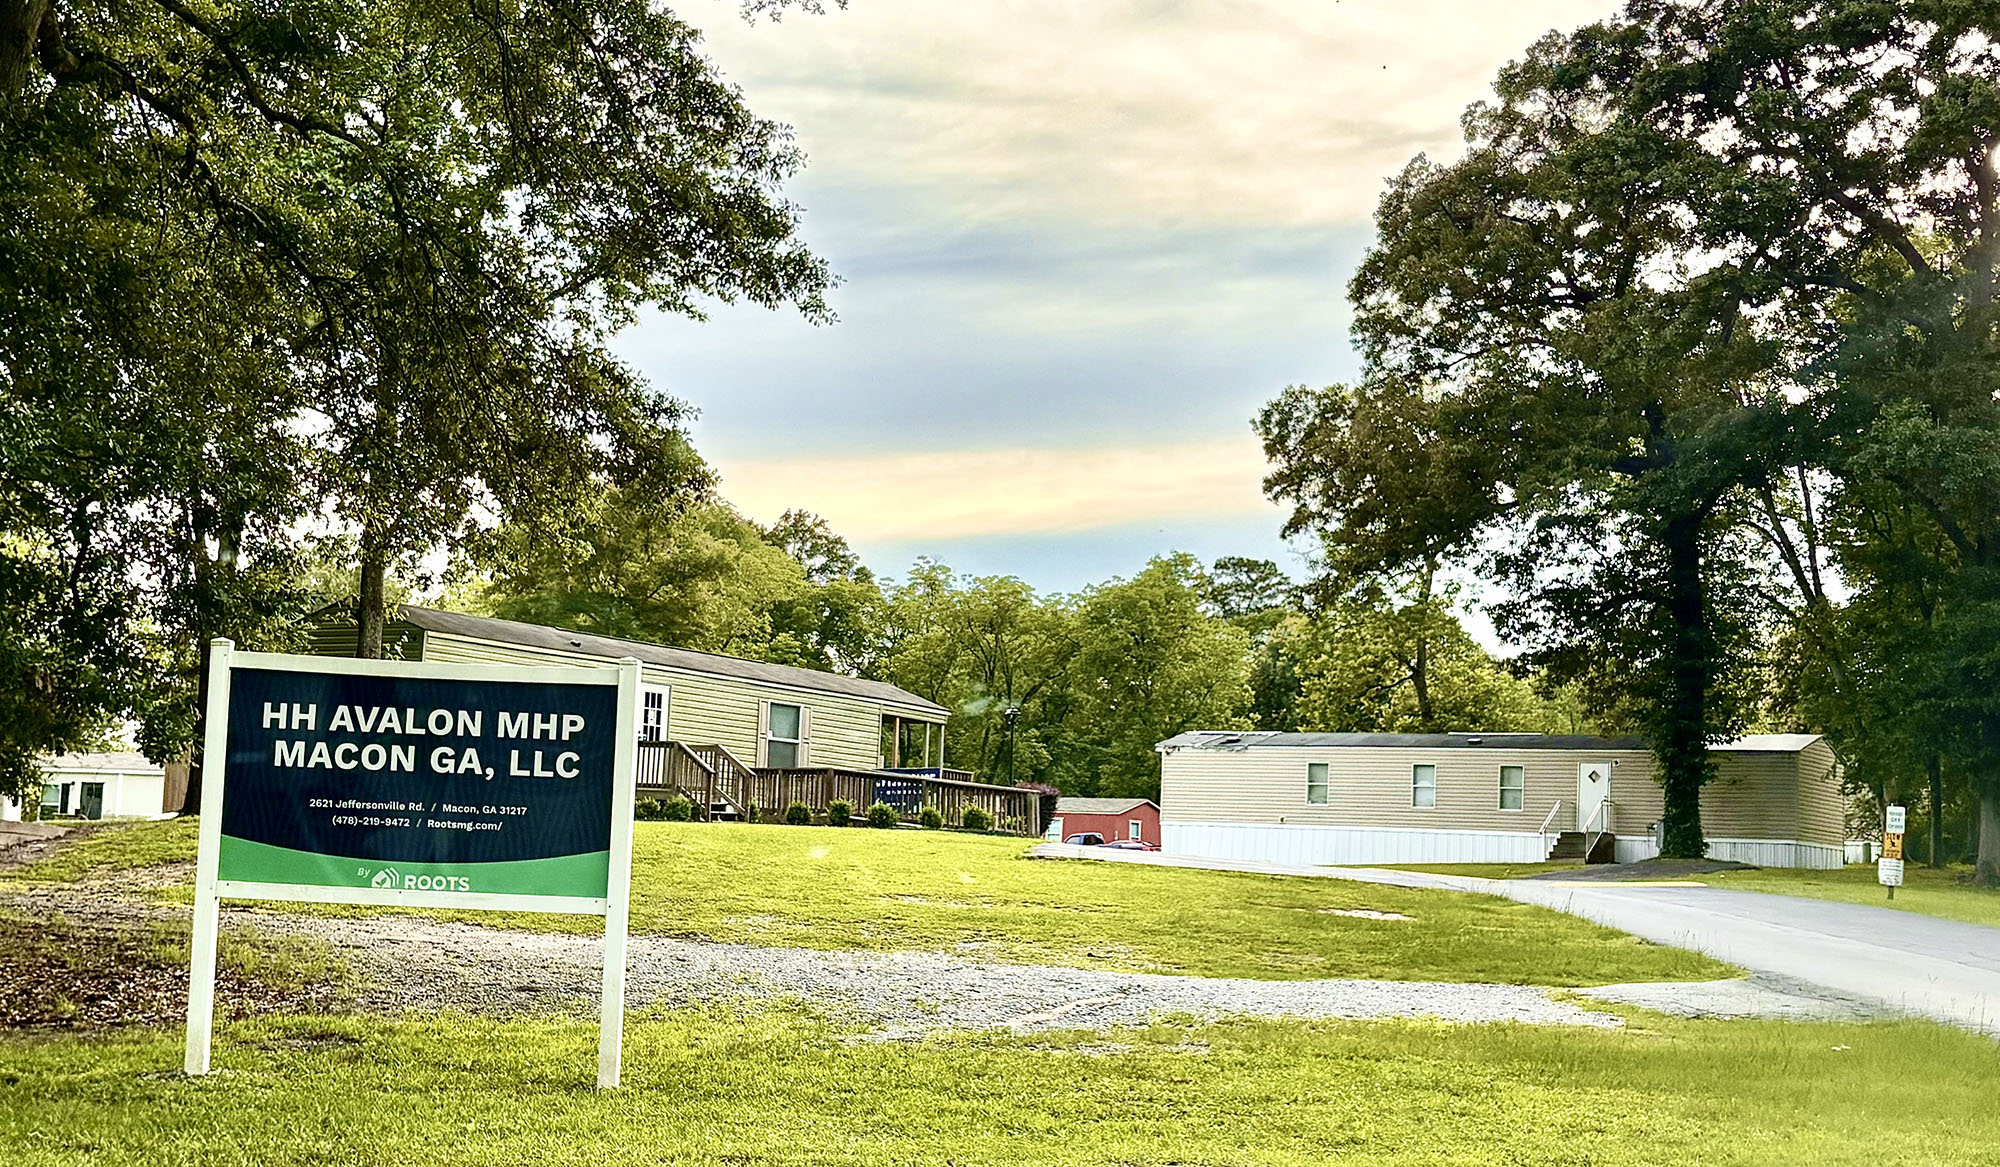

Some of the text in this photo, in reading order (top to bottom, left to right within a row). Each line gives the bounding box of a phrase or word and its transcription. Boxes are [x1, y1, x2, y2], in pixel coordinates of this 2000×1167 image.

[262, 701, 585, 741] HH AVALON MHP
[273, 739, 581, 781] MACON GA, LLC
[309, 798, 528, 816] 2621 Jeffersonville Rd. / Macon, GA 31217
[332, 815, 503, 832] (478)-219-9472 / Rootsmg.com/
[357, 867, 470, 891] By ROOTS
